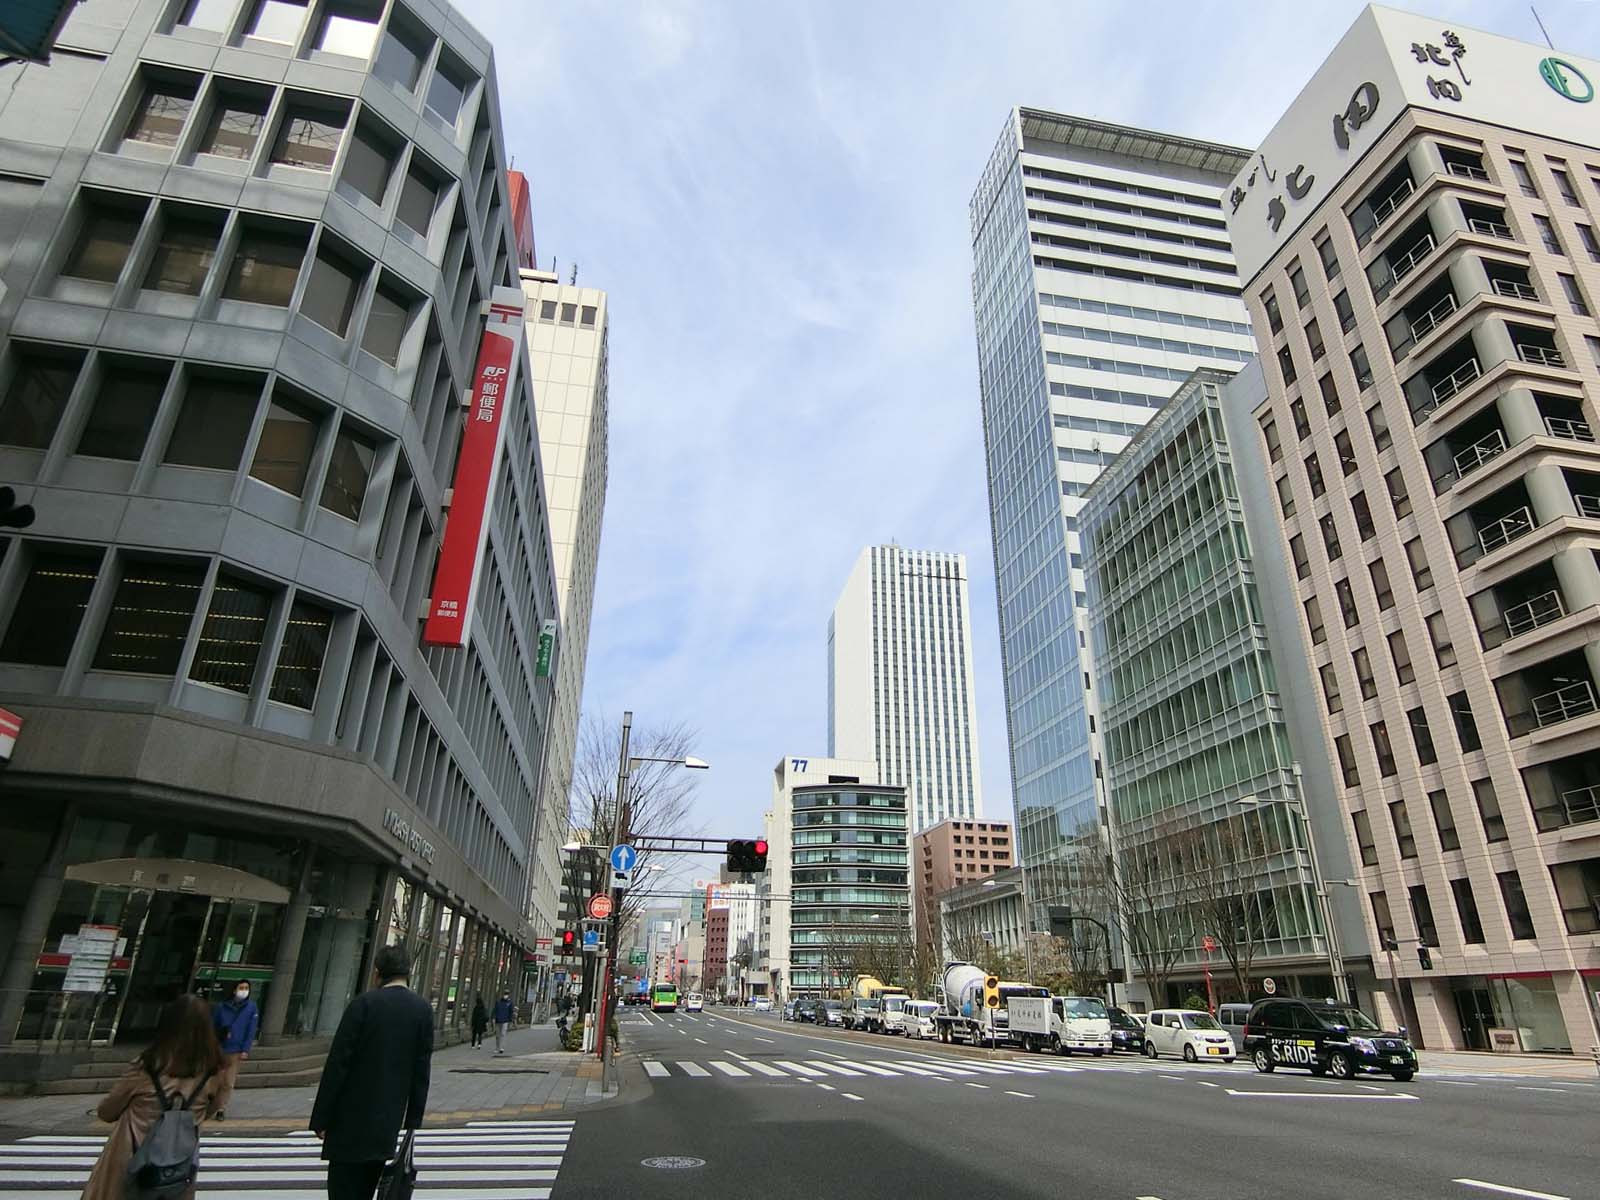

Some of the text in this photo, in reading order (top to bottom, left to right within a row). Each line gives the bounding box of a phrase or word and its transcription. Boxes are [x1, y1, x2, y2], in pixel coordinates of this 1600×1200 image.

[476, 382, 499, 423] 郵便局
[791, 759, 808, 773] 77
[1271, 1044, 1319, 1065] S.RIDE
